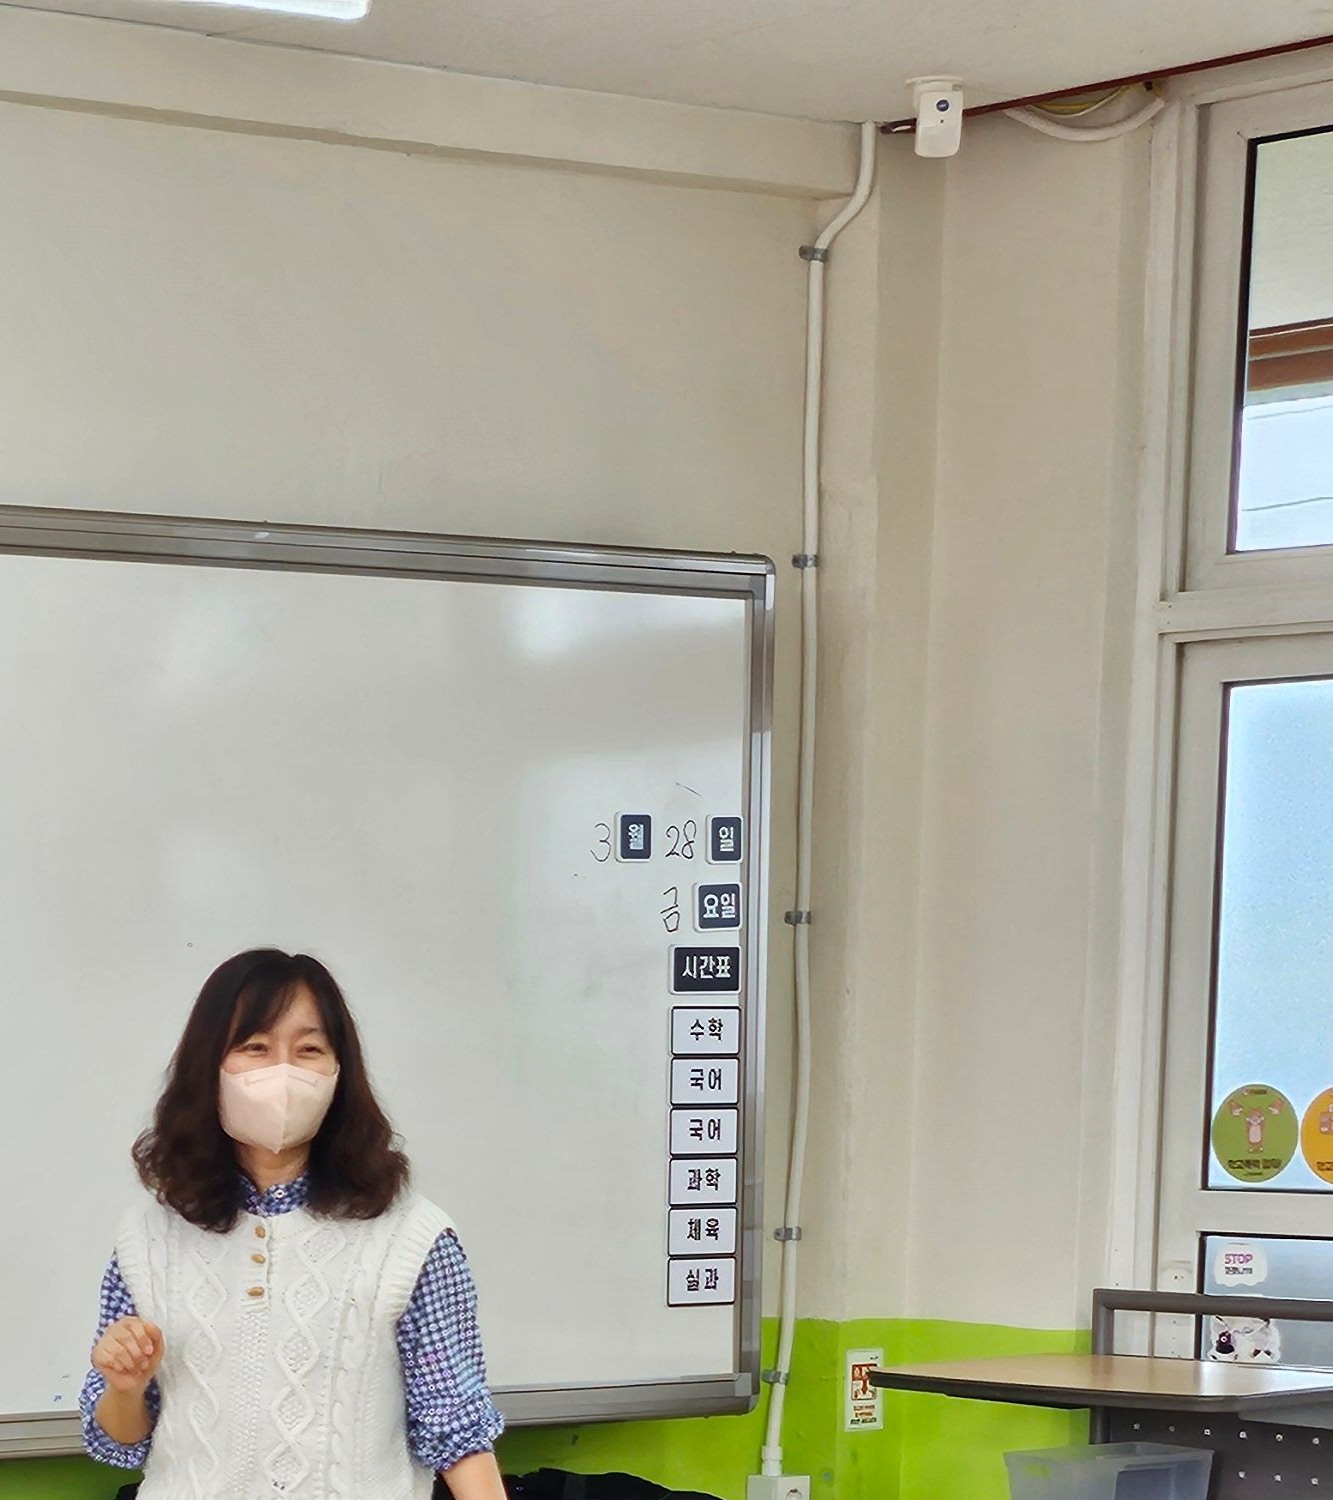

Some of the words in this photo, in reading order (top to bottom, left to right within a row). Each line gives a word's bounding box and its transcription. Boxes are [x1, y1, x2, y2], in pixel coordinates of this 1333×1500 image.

[590, 822, 612, 862] 3
[627, 823, 645, 851] 월
[665, 820, 697, 860] 28
[719, 826, 735, 853] 일
[660, 886, 681, 933] 금
[703, 893, 736, 919] 요일
[682, 955, 732, 979] 시간표
[690, 1018, 724, 1041] 수학
[690, 1068, 722, 1092] 국어
[689, 1118, 722, 1142] 국어
[687, 1168, 721, 1192] 과학
[687, 1218, 720, 1242] 체육
[1224, 1253, 1253, 1265] STOP
[686, 1268, 719, 1292] 실과
